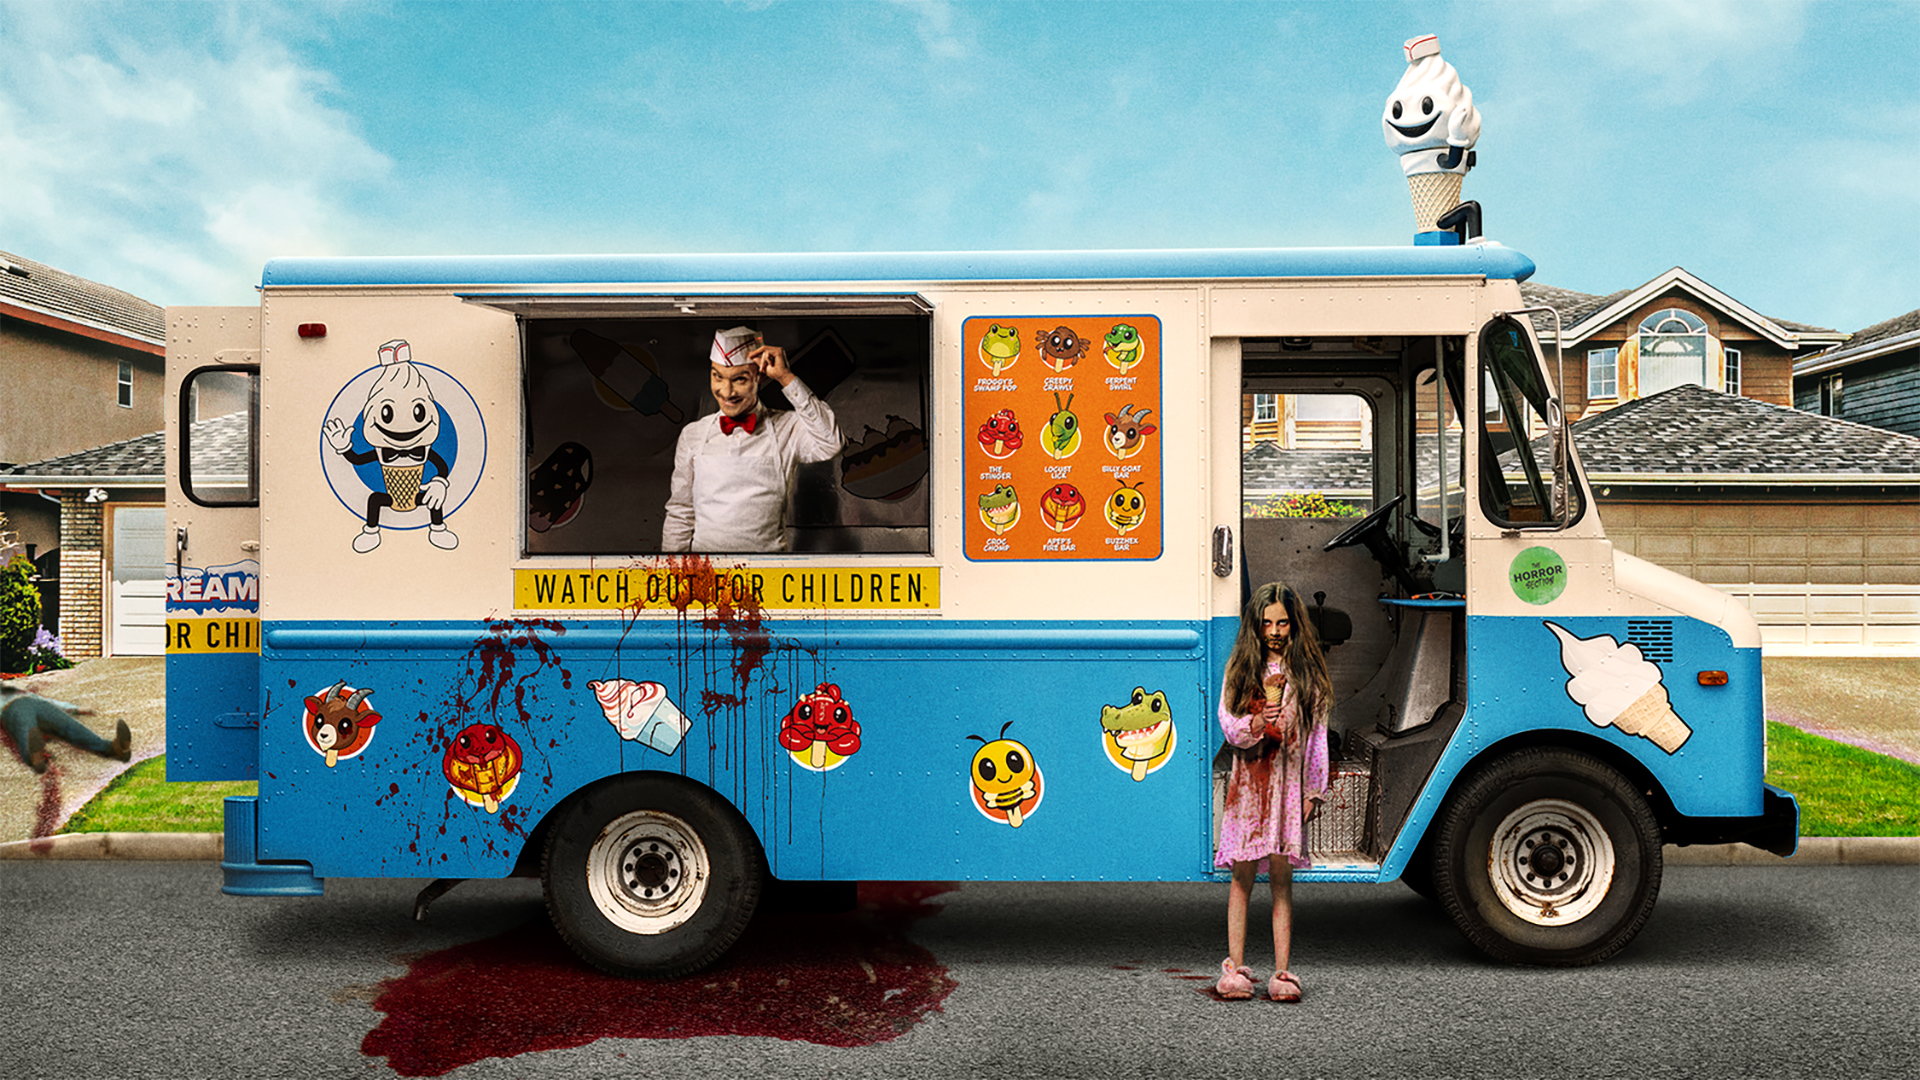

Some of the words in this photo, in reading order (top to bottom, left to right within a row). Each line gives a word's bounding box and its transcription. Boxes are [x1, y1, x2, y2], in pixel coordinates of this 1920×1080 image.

[980, 472, 1011, 480] STINGER
[1514, 565, 1562, 583] HORROR
[534, 573, 629, 604] WATCH
[646, 573, 697, 604] OUT
[715, 573, 764, 604] FOR
[782, 573, 923, 604] CHILDREN
